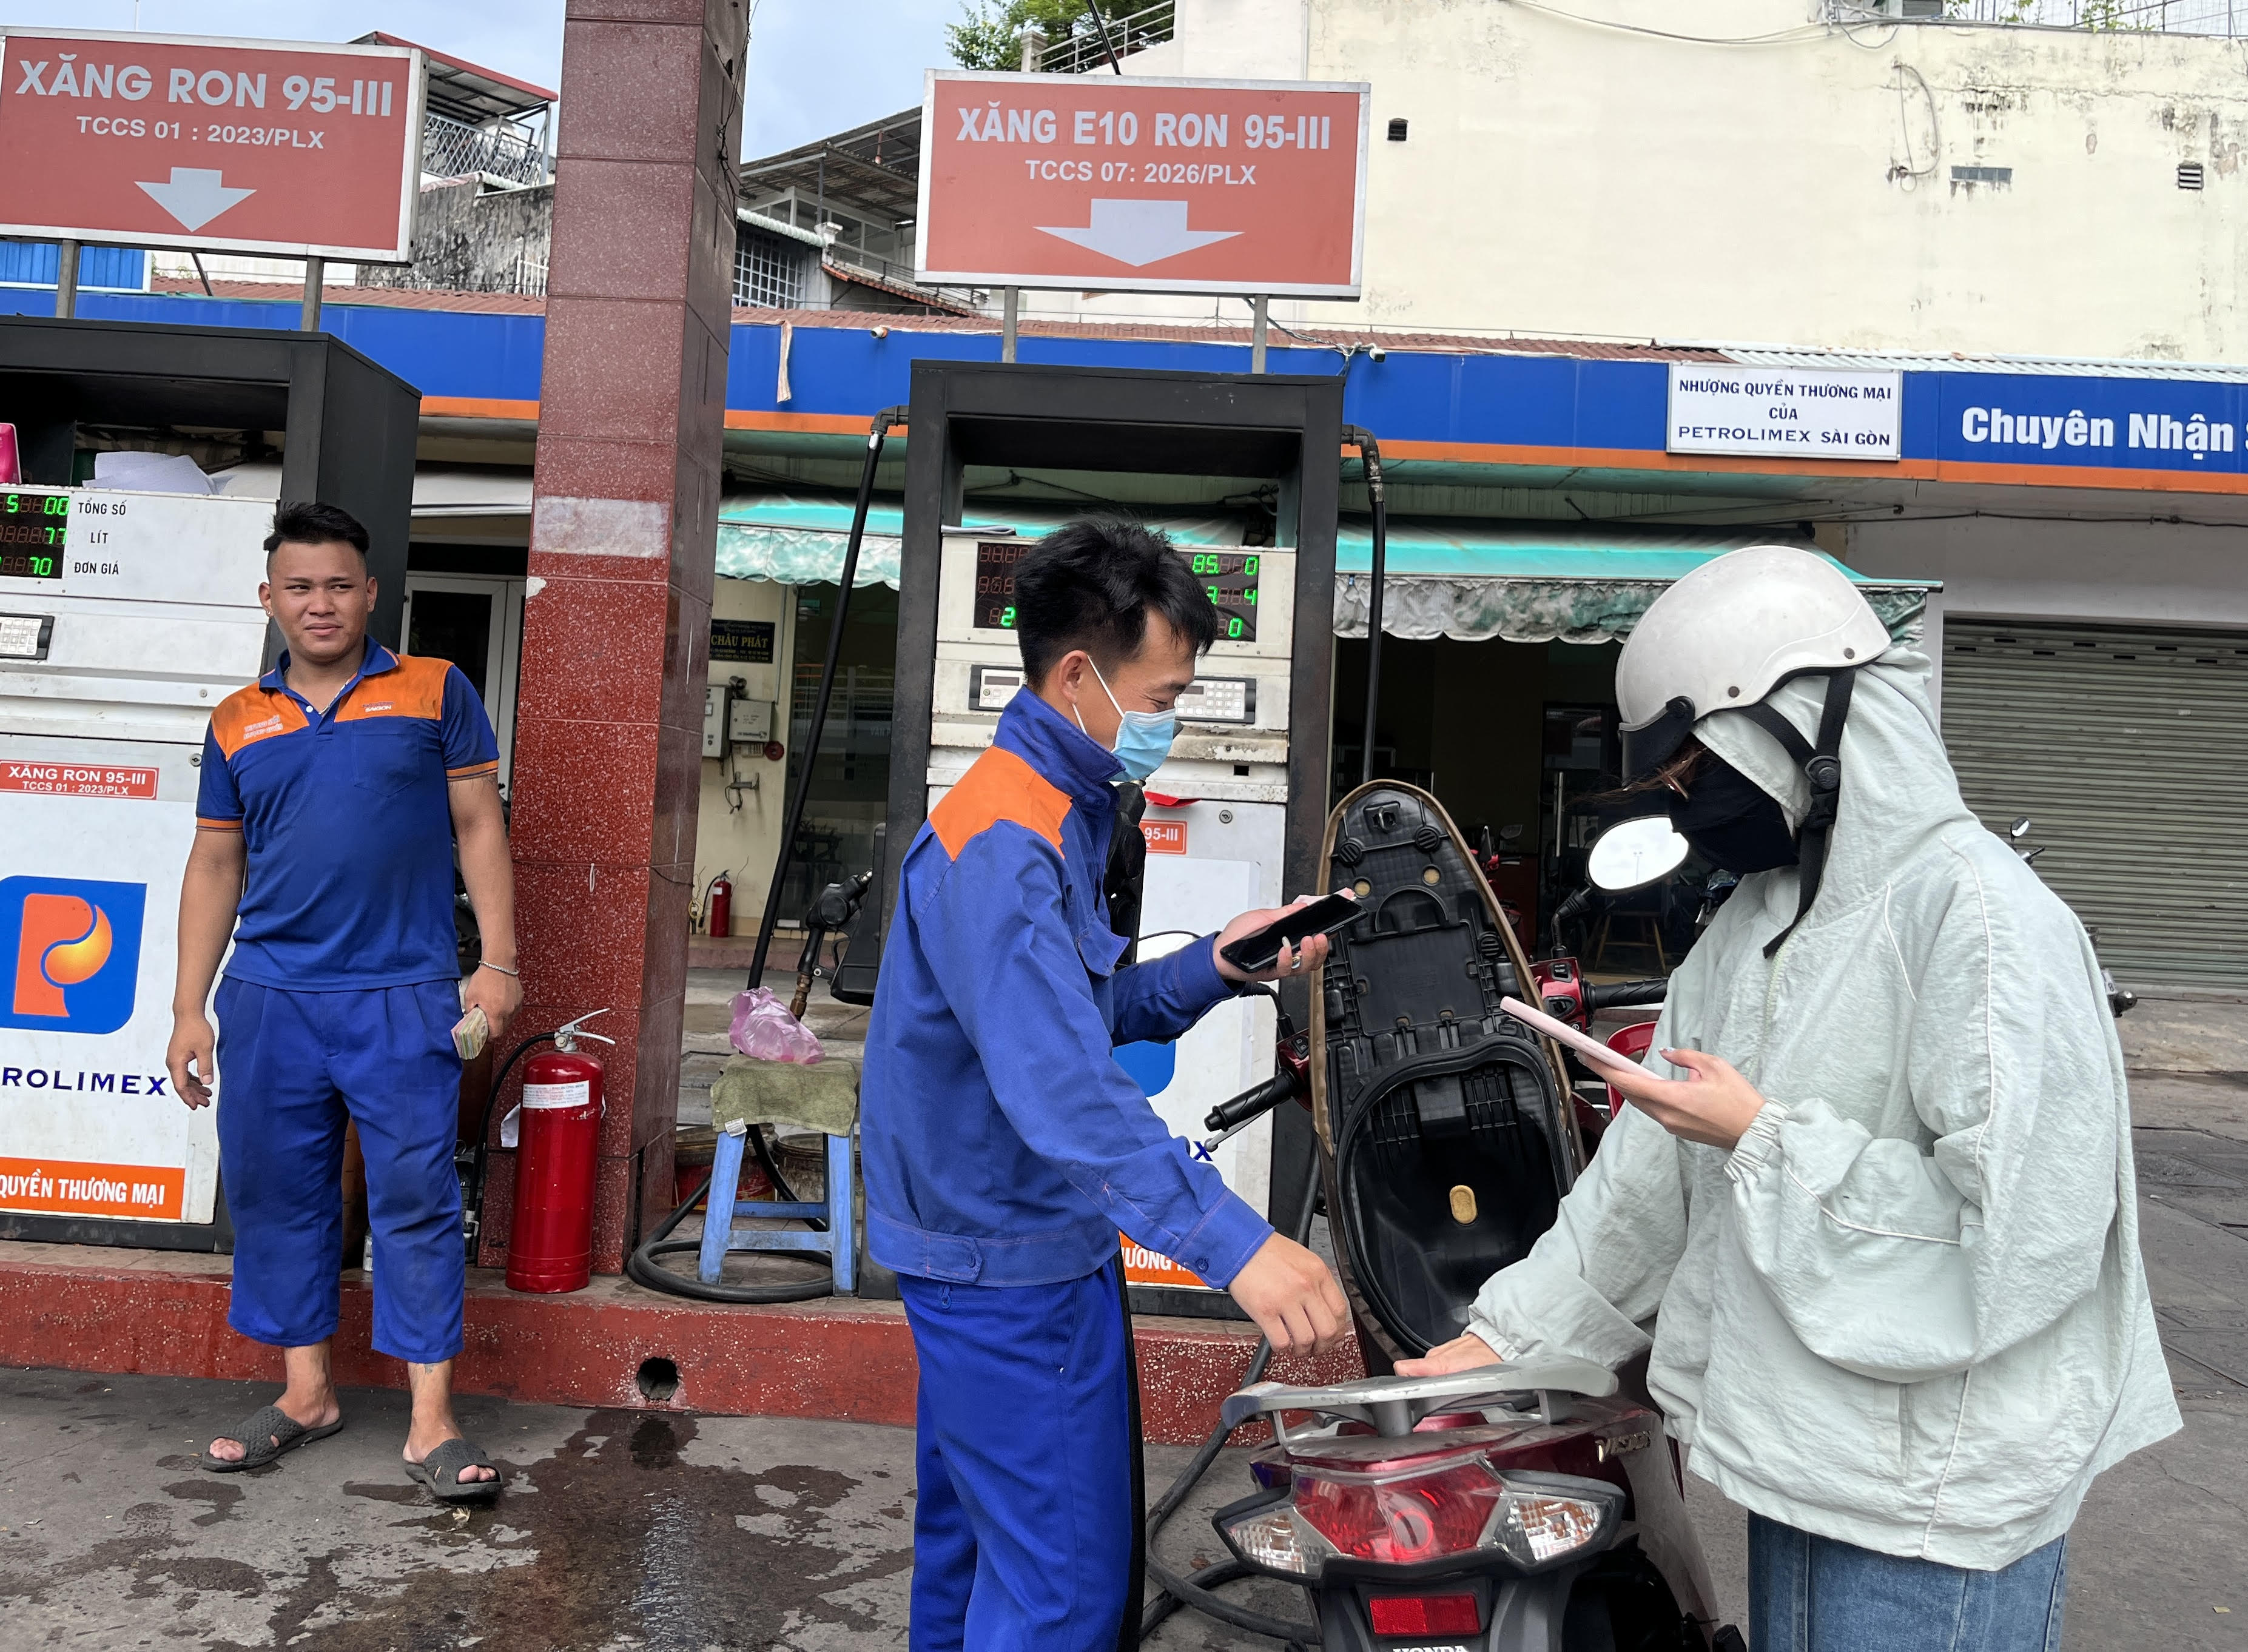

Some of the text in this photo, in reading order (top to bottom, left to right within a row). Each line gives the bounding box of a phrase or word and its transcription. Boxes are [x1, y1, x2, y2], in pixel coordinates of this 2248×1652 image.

[16, 53, 392, 116] XĂNG RON 95-III
[76, 116, 146, 138] TCCS
[155, 121, 180, 140] 01
[207, 124, 326, 149] 2023/PLX
[957, 100, 1330, 150] XĂNG E10 RON 95-III
[1026, 160, 1256, 186] TCCS 07: 2026/PLX
[1679, 378, 1891, 402] NHƯỢNG QUYỀN THƯƠNG MẠI
[1769, 403, 1798, 420] CỦA
[1678, 426, 1890, 446] PETROLIMEX SÀI GÒN
[1962, 406, 2114, 449] Chuyên
[2128, 412, 2234, 460] Nhận
[78, 497, 127, 515] TỔNG SỐ
[91, 529, 109, 543] LÍT
[74, 560, 119, 575] ĐƠN GIÁ
[8, 765, 146, 785] XĂNG RON 95-III
[22, 781, 52, 791] TCCS
[56, 783, 68, 792] 01
[78, 784, 129, 795] 2023/PLX
[1144, 827, 1178, 841] 95-III
[1, 1067, 168, 1096] ROLIMEX
[0, 1168, 165, 1209] QUYỀN THƯƠNG MẠI
